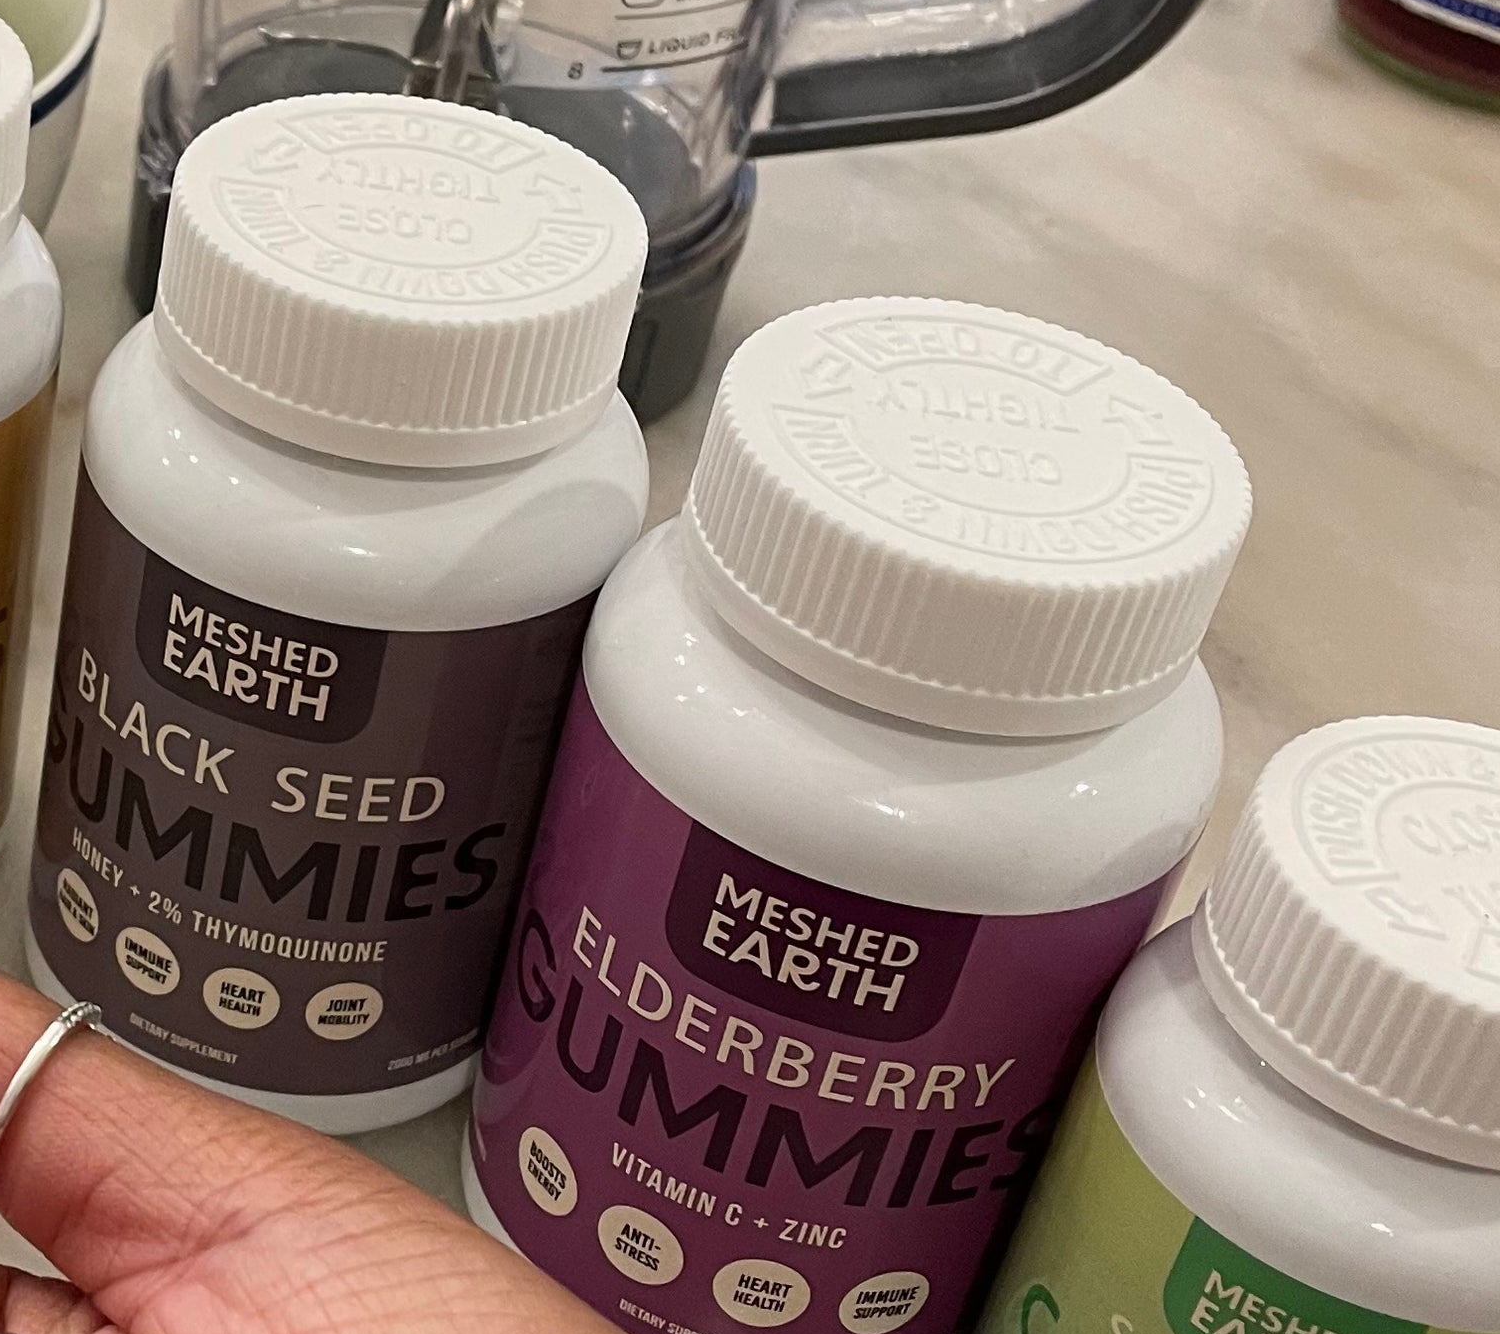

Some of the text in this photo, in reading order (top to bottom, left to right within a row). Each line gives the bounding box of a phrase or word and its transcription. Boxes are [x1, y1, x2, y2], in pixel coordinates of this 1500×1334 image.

[568, 62, 584, 80] 8
[168, 592, 339, 679] MESHED
[162, 630, 331, 723] EARTH
[78, 647, 446, 823] BLACK SEED
[71, 826, 124, 889] HONEY
[147, 890, 183, 926] 2%
[191, 910, 388, 963] THYMOQUINONE
[714, 871, 921, 969] MESHED
[124, 935, 174, 975] IMMUNE
[701, 907, 906, 1014] EARTH
[218, 996, 262, 1018] HEALTH
[220, 980, 266, 1005] HEART
[326, 997, 368, 1013] JOINT
[572, 904, 1017, 1113] ELDERBERRY
[170, 1032, 239, 1065] SUPPLEMENT
[516, 907, 1052, 1209] GUMMIES
[527, 1157, 562, 1202] ENERGY
[529, 1139, 568, 1191] BOOSTS
[612, 1141, 718, 1218] VITAMIN
[723, 1202, 744, 1227] C
[777, 1217, 848, 1250] ZINC
[614, 1237, 660, 1273] STRESS
[620, 1223, 662, 1253] ANTI-
[732, 1289, 786, 1314] HEALTH
[737, 1273, 794, 1300] HEART
[855, 1285, 921, 1306] IMMUNE
[618, 1297, 668, 1330] DIETARY
[852, 1302, 911, 1321] SUPPORT
